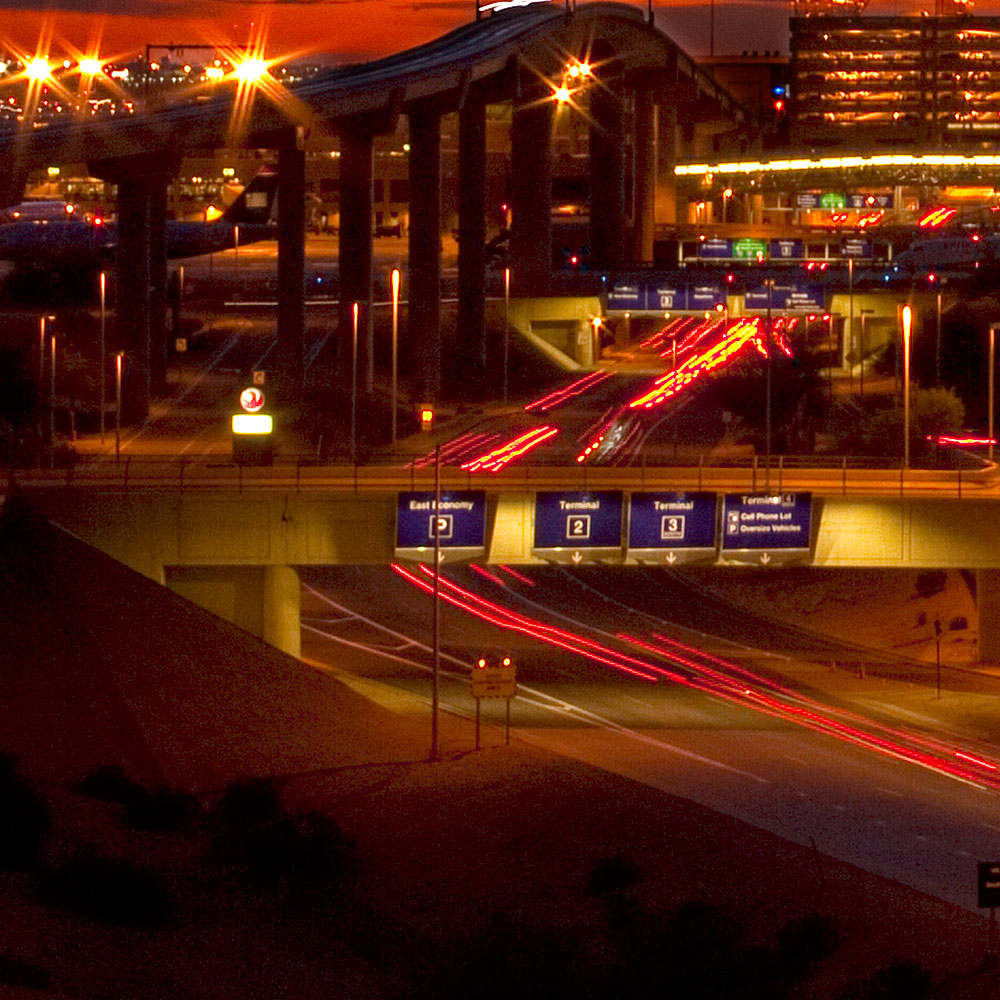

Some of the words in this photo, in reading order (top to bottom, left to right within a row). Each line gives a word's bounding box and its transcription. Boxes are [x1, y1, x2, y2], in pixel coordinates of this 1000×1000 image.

[410, 501, 430, 510] East
[560, 501, 600, 510] Terminal
[654, 501, 694, 510] Terminal
[741, 512, 755, 520] Cell
[757, 512, 779, 520] Phone
[780, 512, 792, 520] Lot
[574, 520, 584, 533] 2
[668, 518, 678, 531] 3
